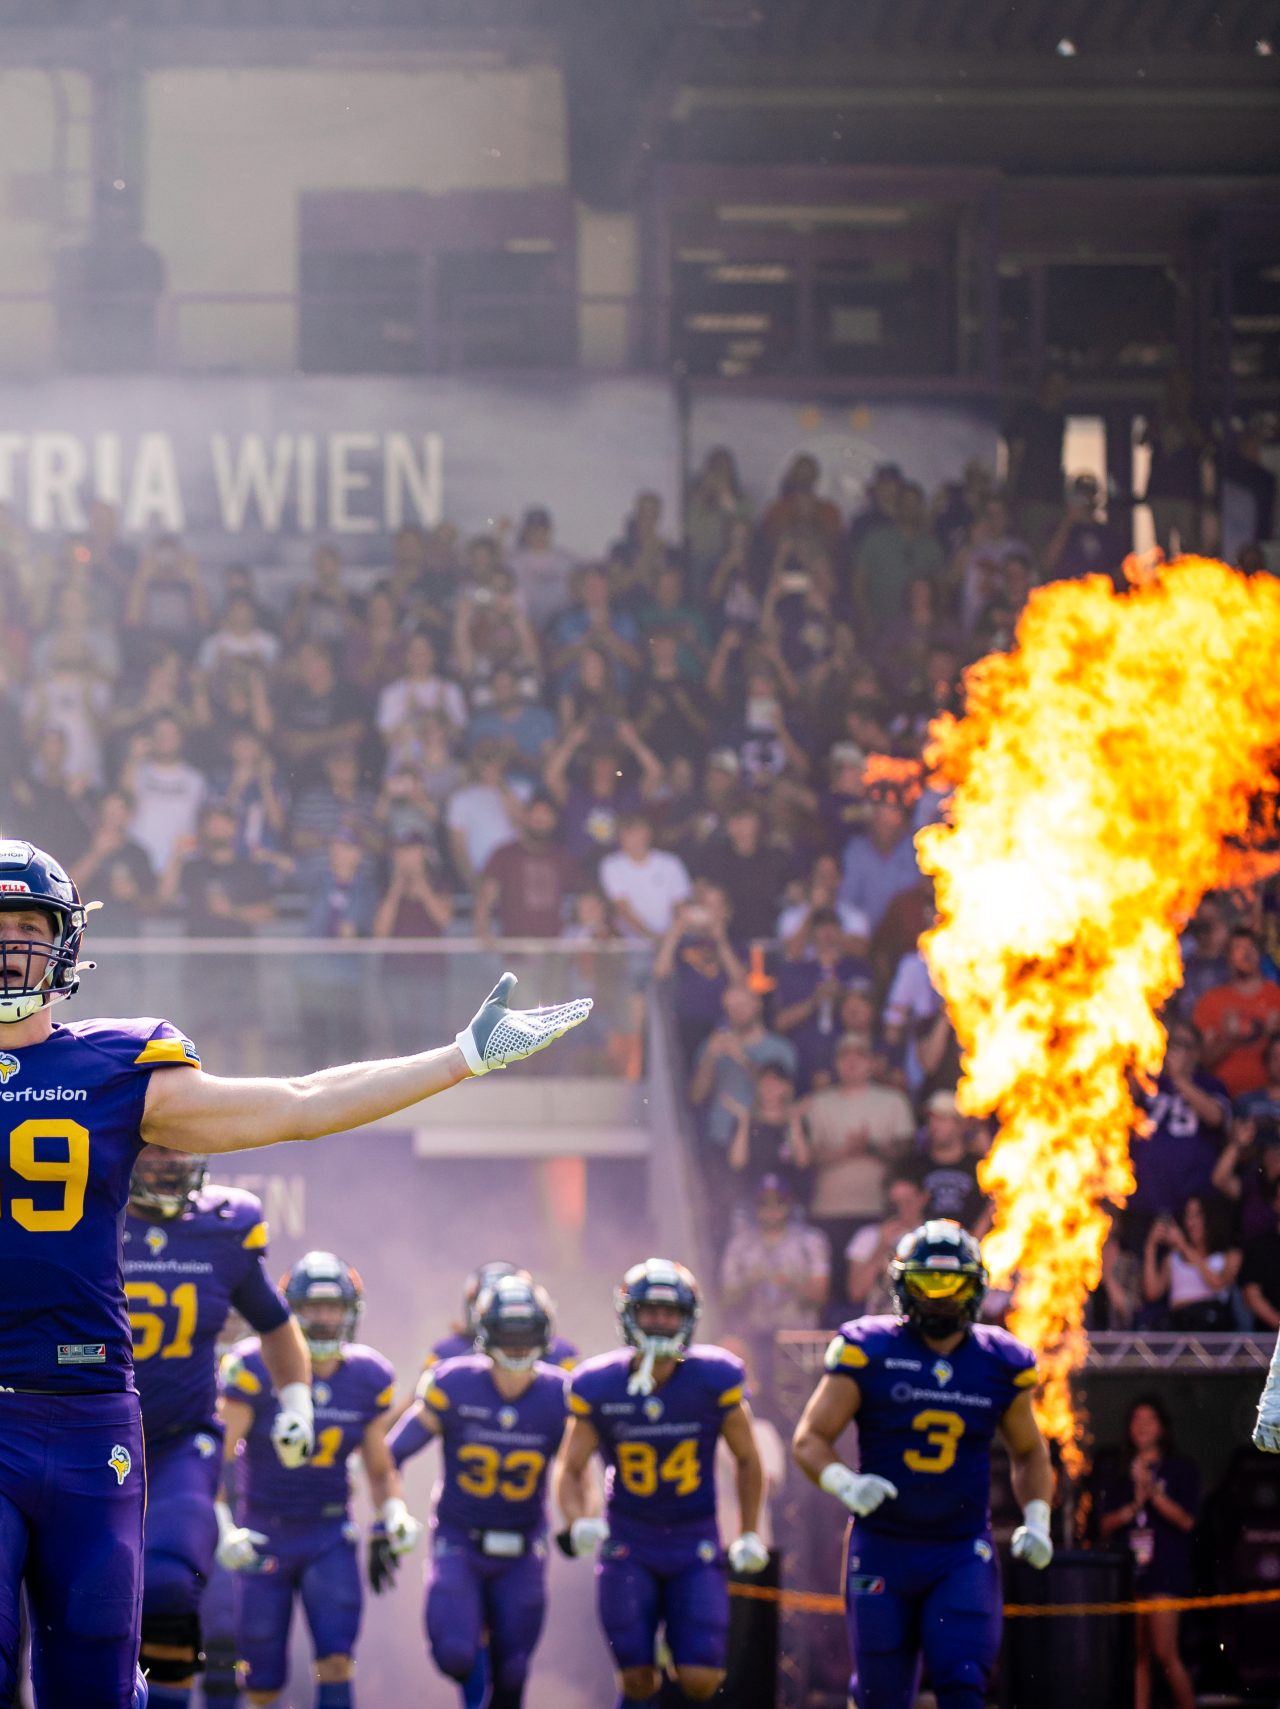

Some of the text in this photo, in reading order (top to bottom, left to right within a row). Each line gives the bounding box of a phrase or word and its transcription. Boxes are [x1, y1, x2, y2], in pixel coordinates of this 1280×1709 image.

[213, 431, 446, 533] WIEN
[123, 1282, 198, 1360] 61
[617, 1439, 701, 1497] 84
[902, 1410, 965, 1474] 3
